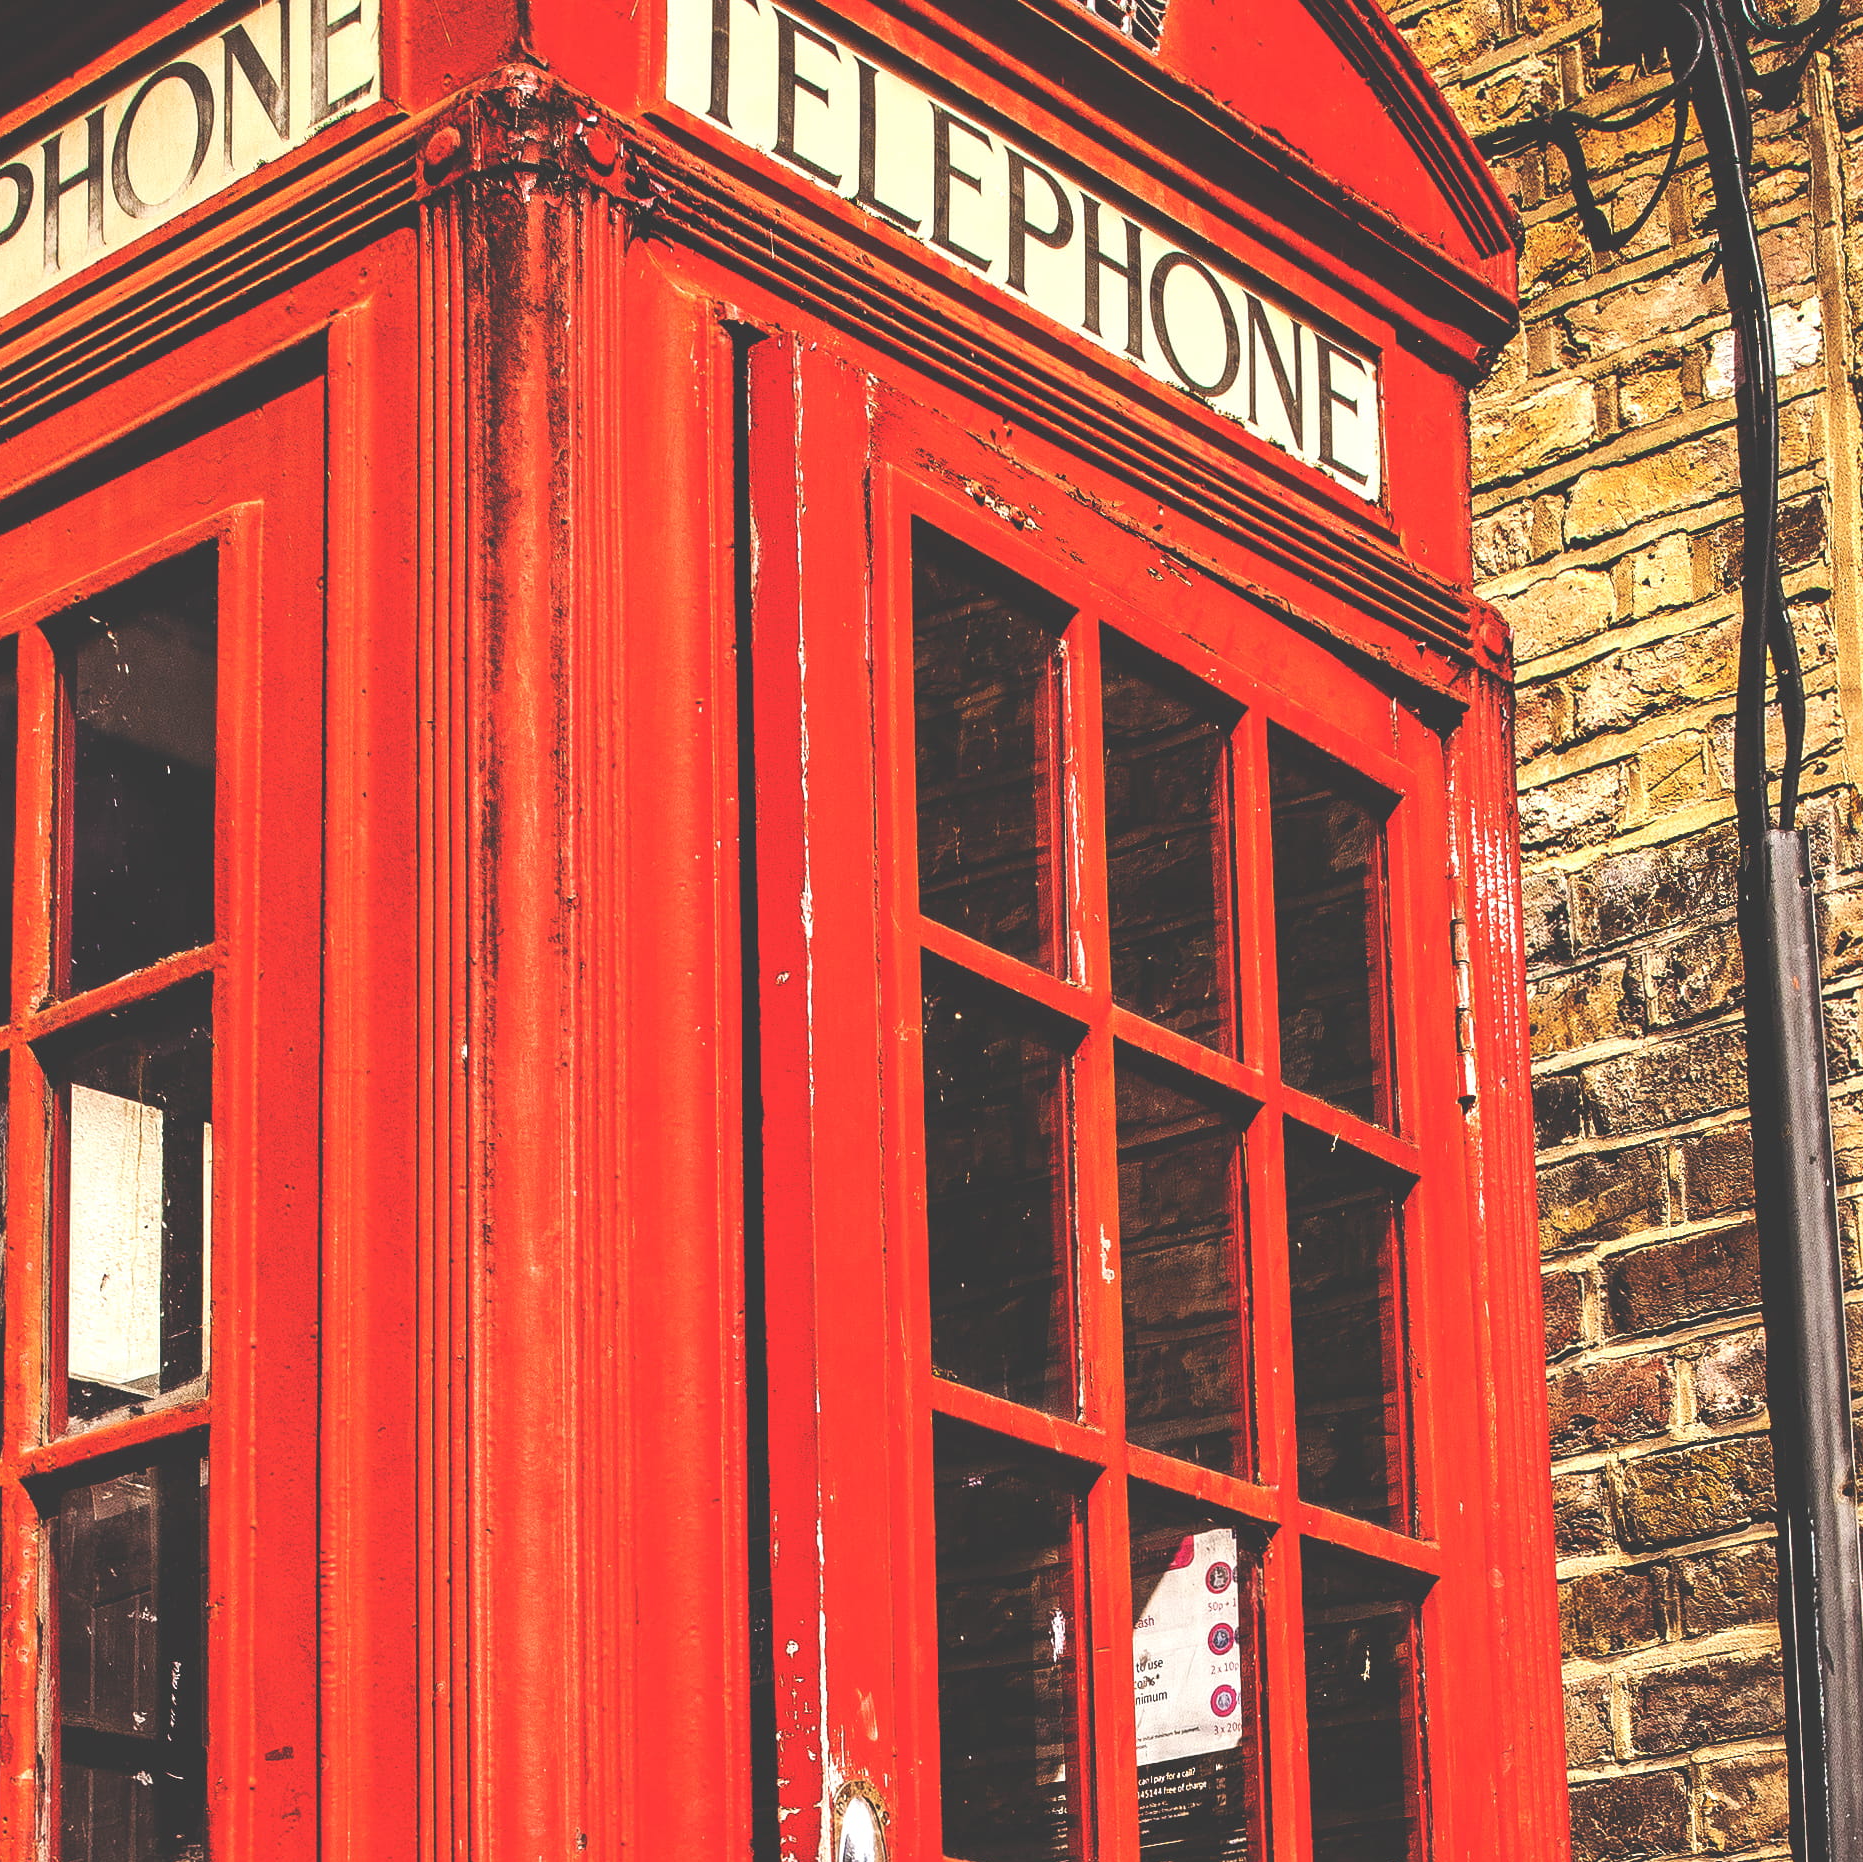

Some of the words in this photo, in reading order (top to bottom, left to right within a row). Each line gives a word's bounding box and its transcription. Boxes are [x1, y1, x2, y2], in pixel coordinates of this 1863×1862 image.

[704, 0, 1370, 485] TELEPHONE
[1148, 1659, 1164, 1670] use
[1153, 1775, 1166, 1784] pay
[1165, 1772, 1176, 1780] for
[1177, 1782, 1185, 1793] of
